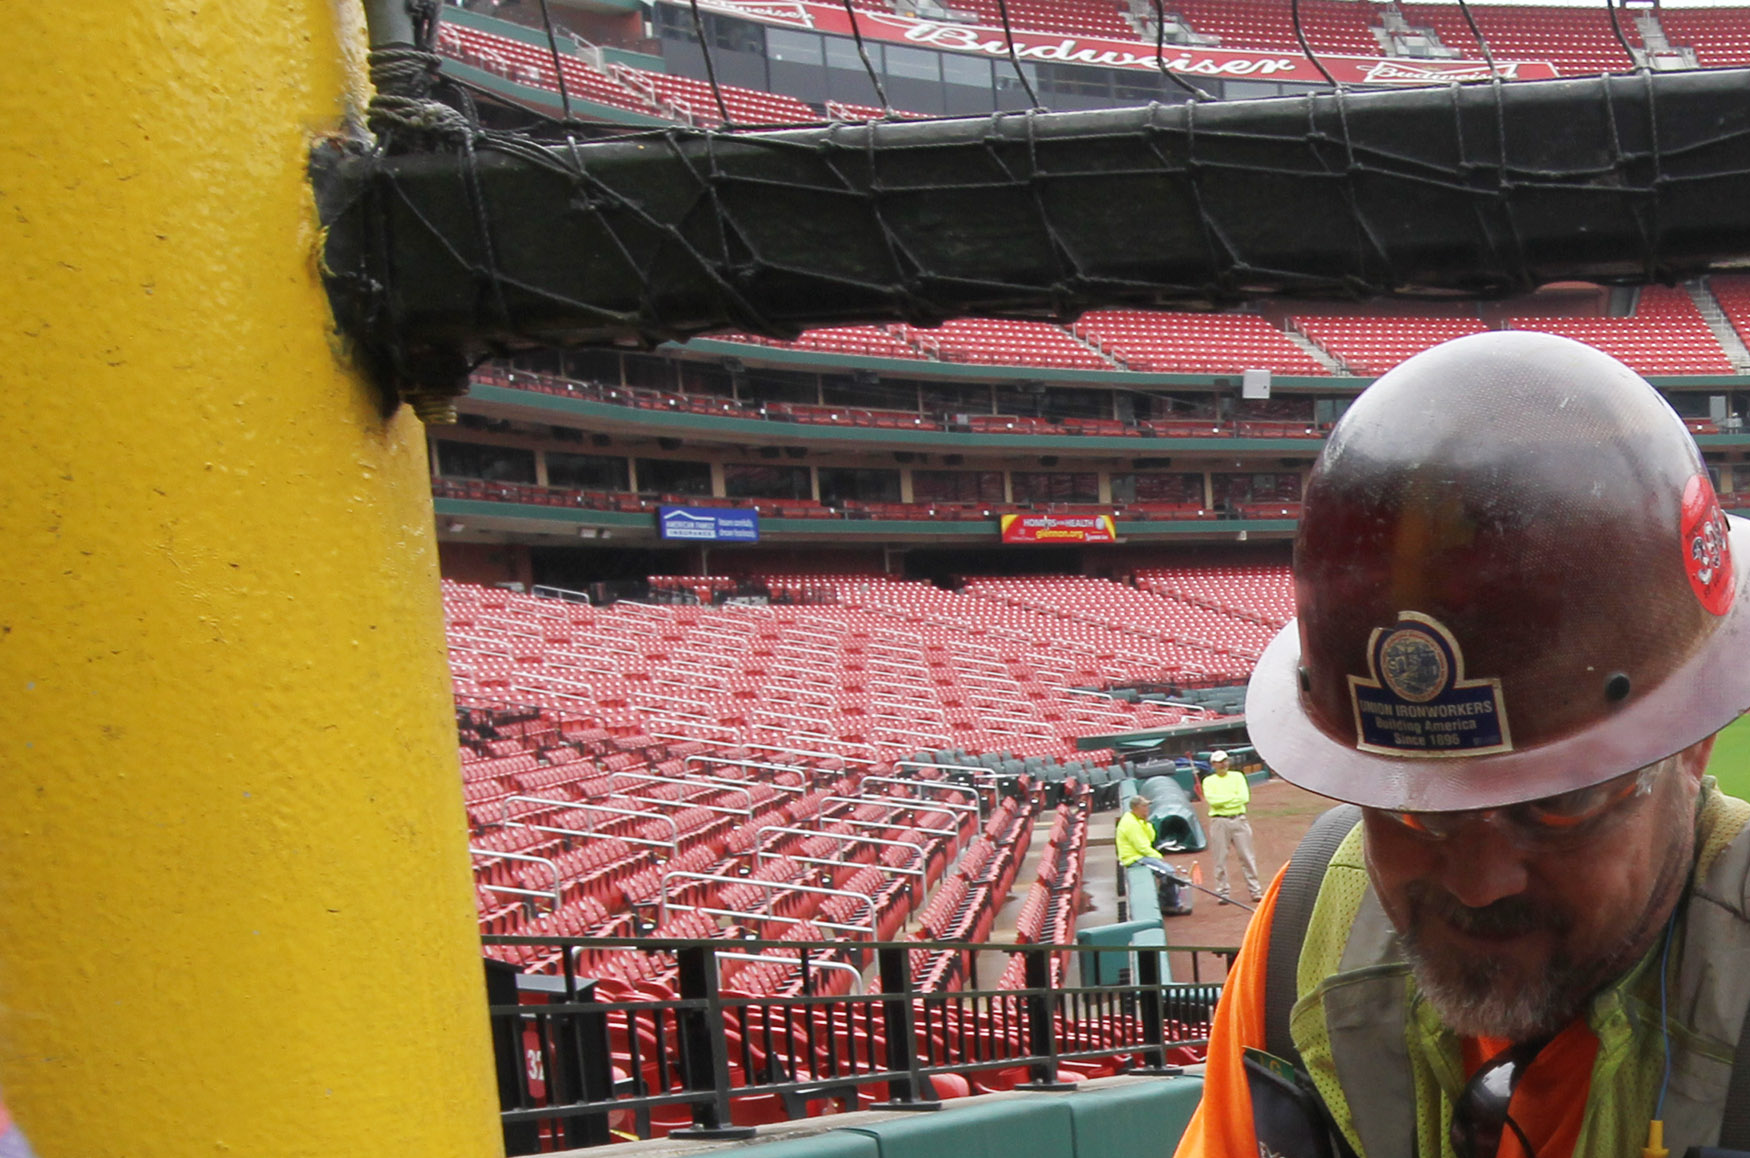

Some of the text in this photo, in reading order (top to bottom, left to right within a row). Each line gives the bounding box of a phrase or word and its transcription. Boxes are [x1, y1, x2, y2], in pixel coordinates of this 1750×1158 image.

[902, 22, 1297, 74] Budweiser
[1359, 700, 1493, 718] UNION IRONWORKERS
[1375, 716, 1477, 734] Building America
[1393, 732, 1426, 746] Since
[1429, 733, 1461, 746] 1896
